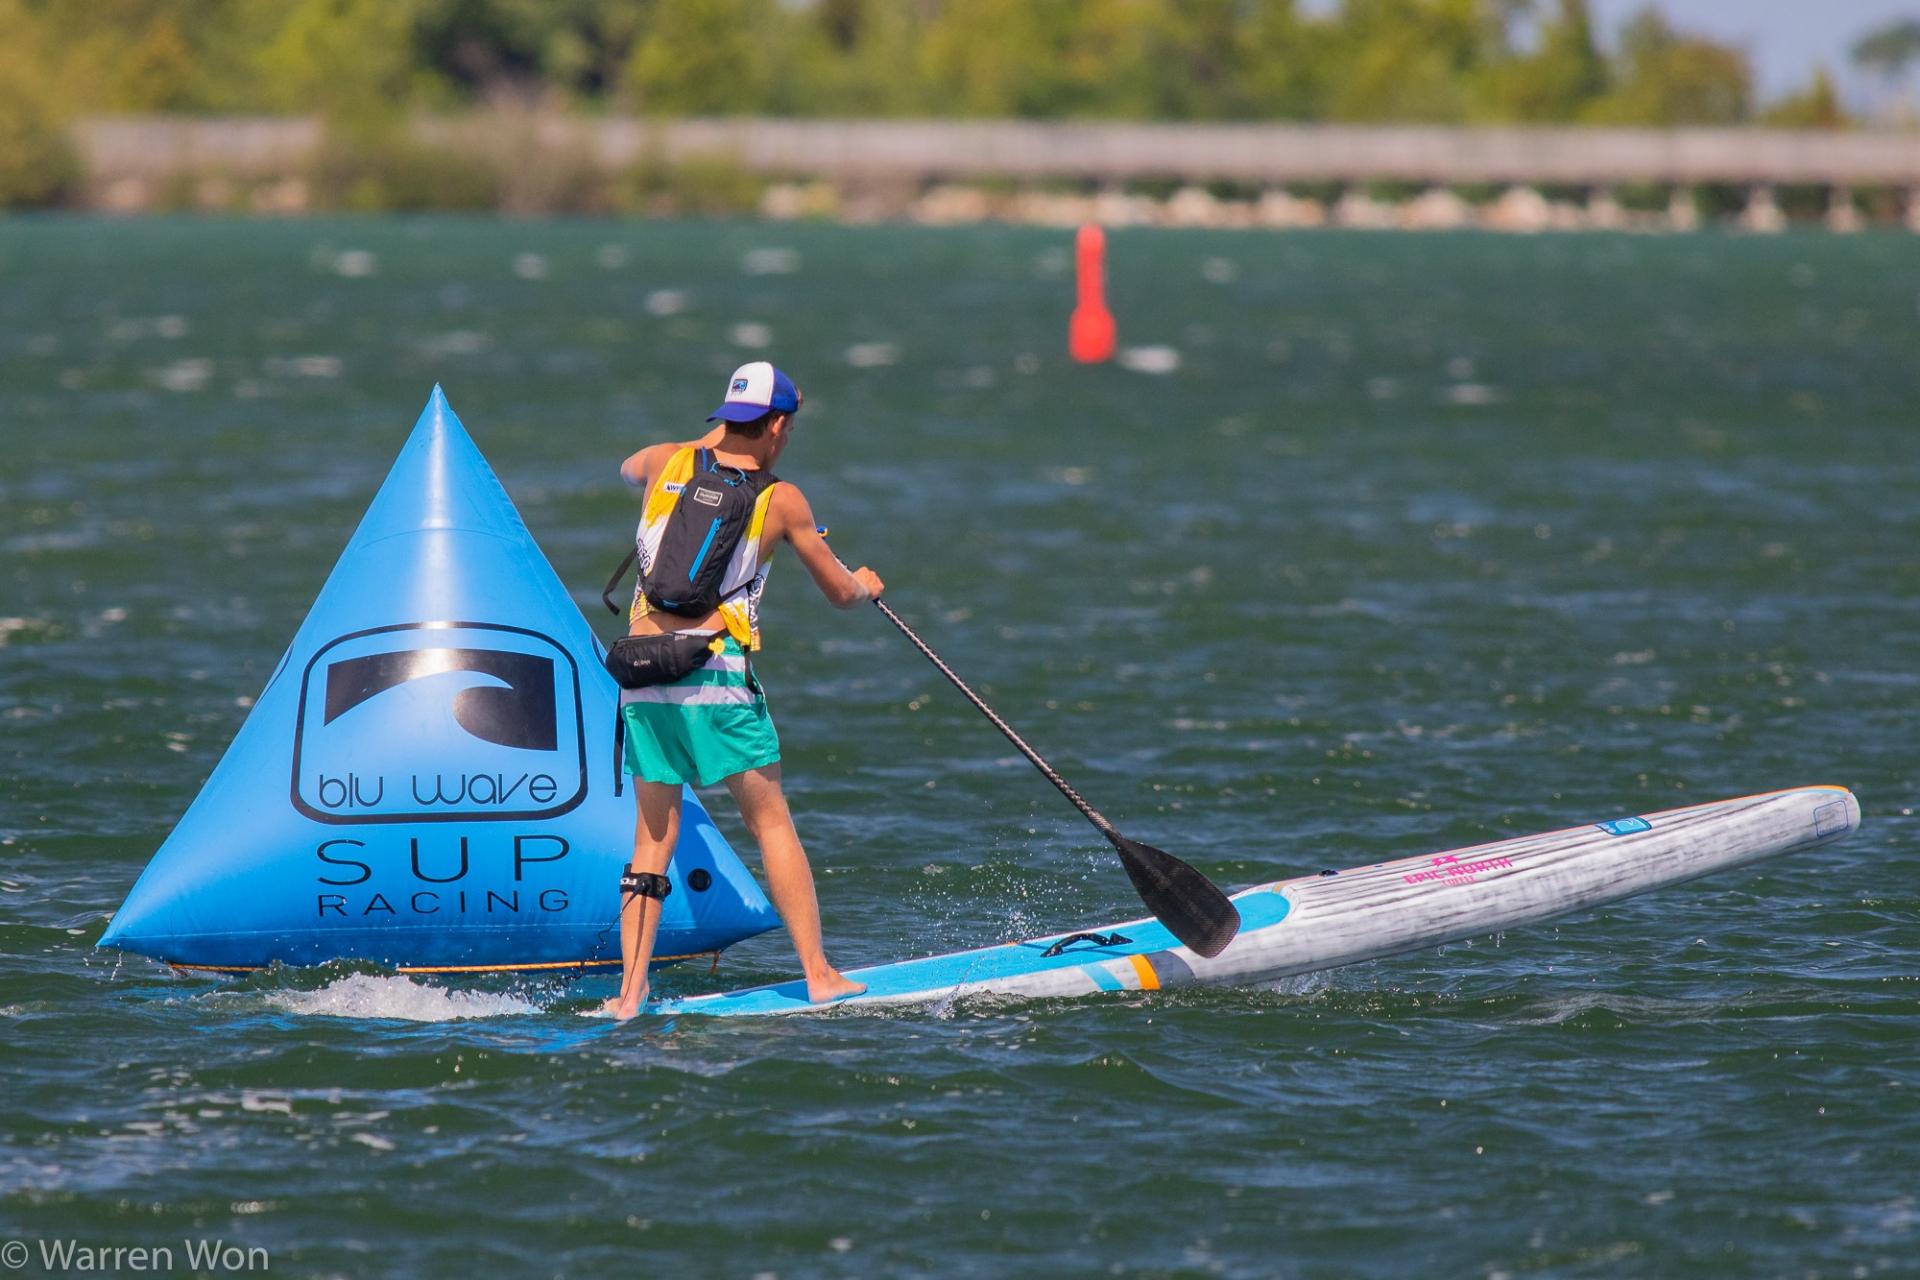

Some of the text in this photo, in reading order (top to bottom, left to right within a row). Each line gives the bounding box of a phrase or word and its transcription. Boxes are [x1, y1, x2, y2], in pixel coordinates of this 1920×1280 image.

[319, 772, 558, 808] blu wave
[316, 835, 570, 886] SUP
[1445, 857, 1513, 877] NORTH
[317, 889, 569, 917] RACING
